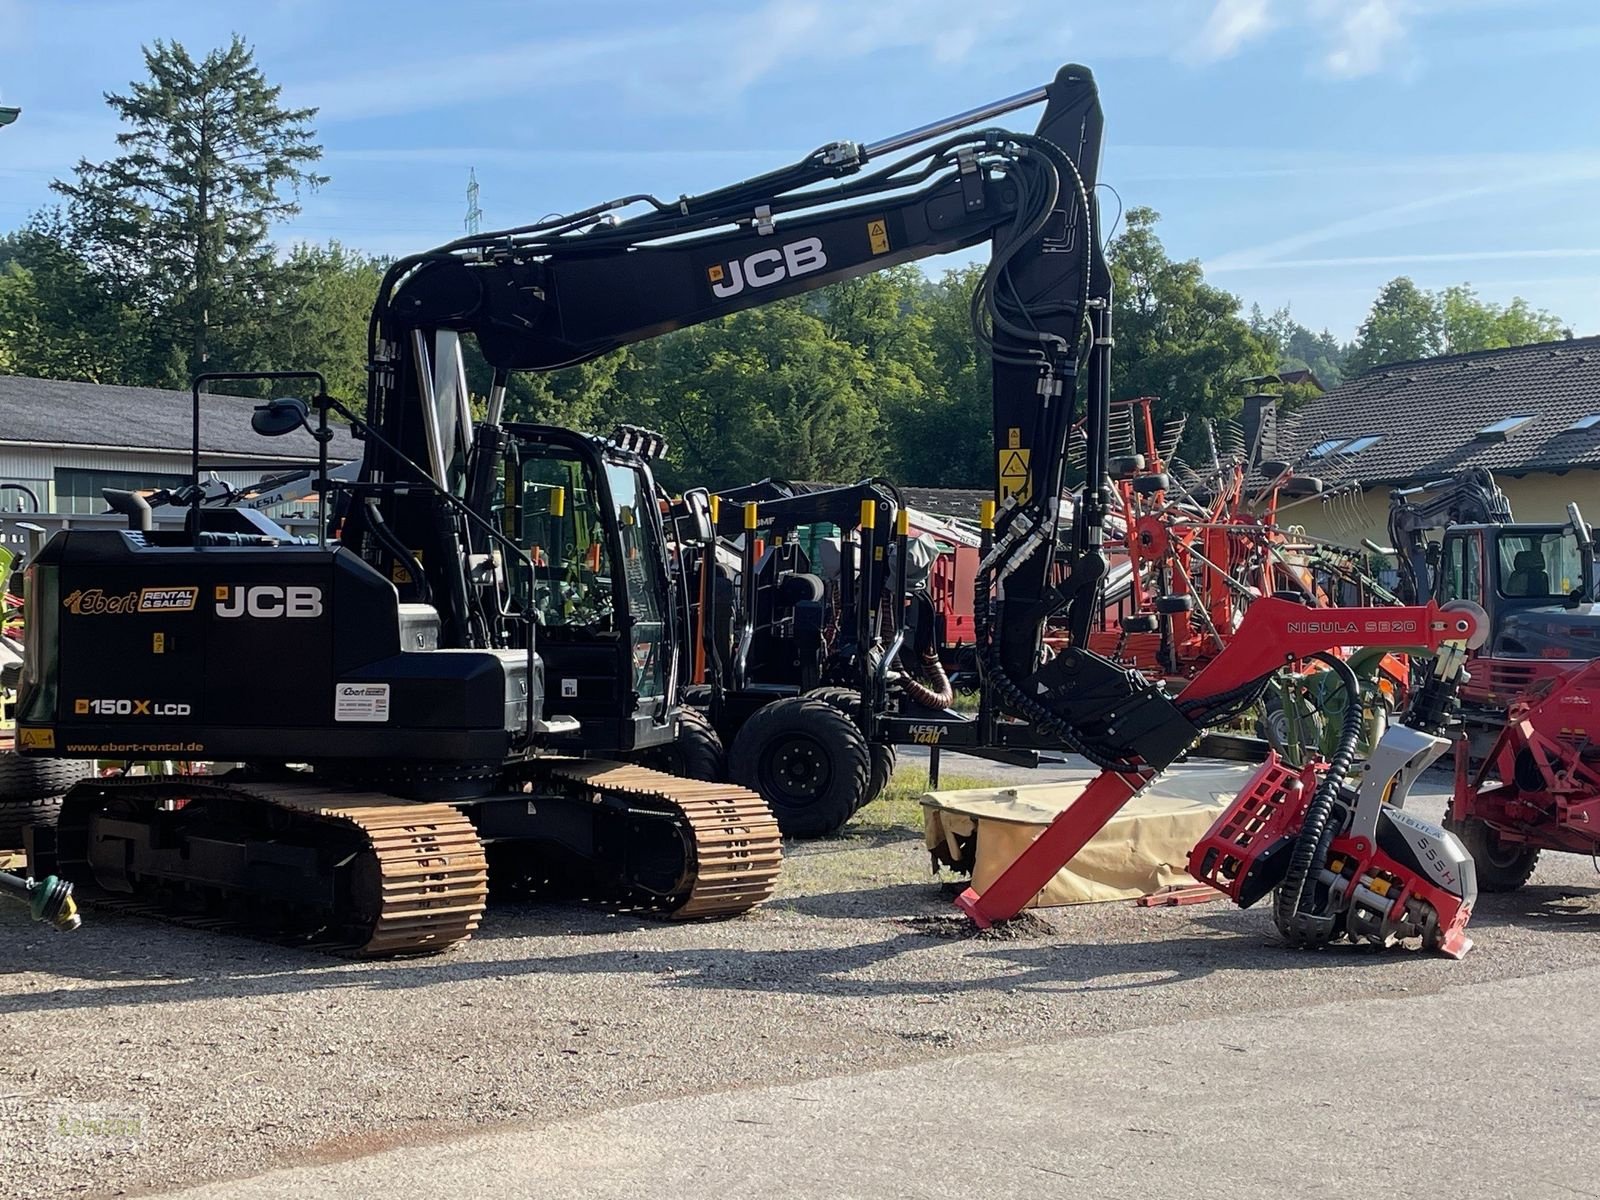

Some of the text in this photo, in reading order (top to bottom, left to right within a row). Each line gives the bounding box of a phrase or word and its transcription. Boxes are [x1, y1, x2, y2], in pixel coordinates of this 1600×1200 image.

[711, 236, 828, 298] JCB
[248, 493, 284, 509] KESLA
[80, 588, 138, 615] Ebert
[144, 591, 193, 600] RENTAL
[215, 586, 323, 617] JCB
[142, 599, 191, 608] & SALES
[1287, 620, 1417, 633] NISULA SB20
[154, 704, 191, 716] LCD
[908, 724, 949, 735] KESLA
[66, 742, 204, 752] www.ebert-rental.de
[1390, 810, 1442, 839] NISULA
